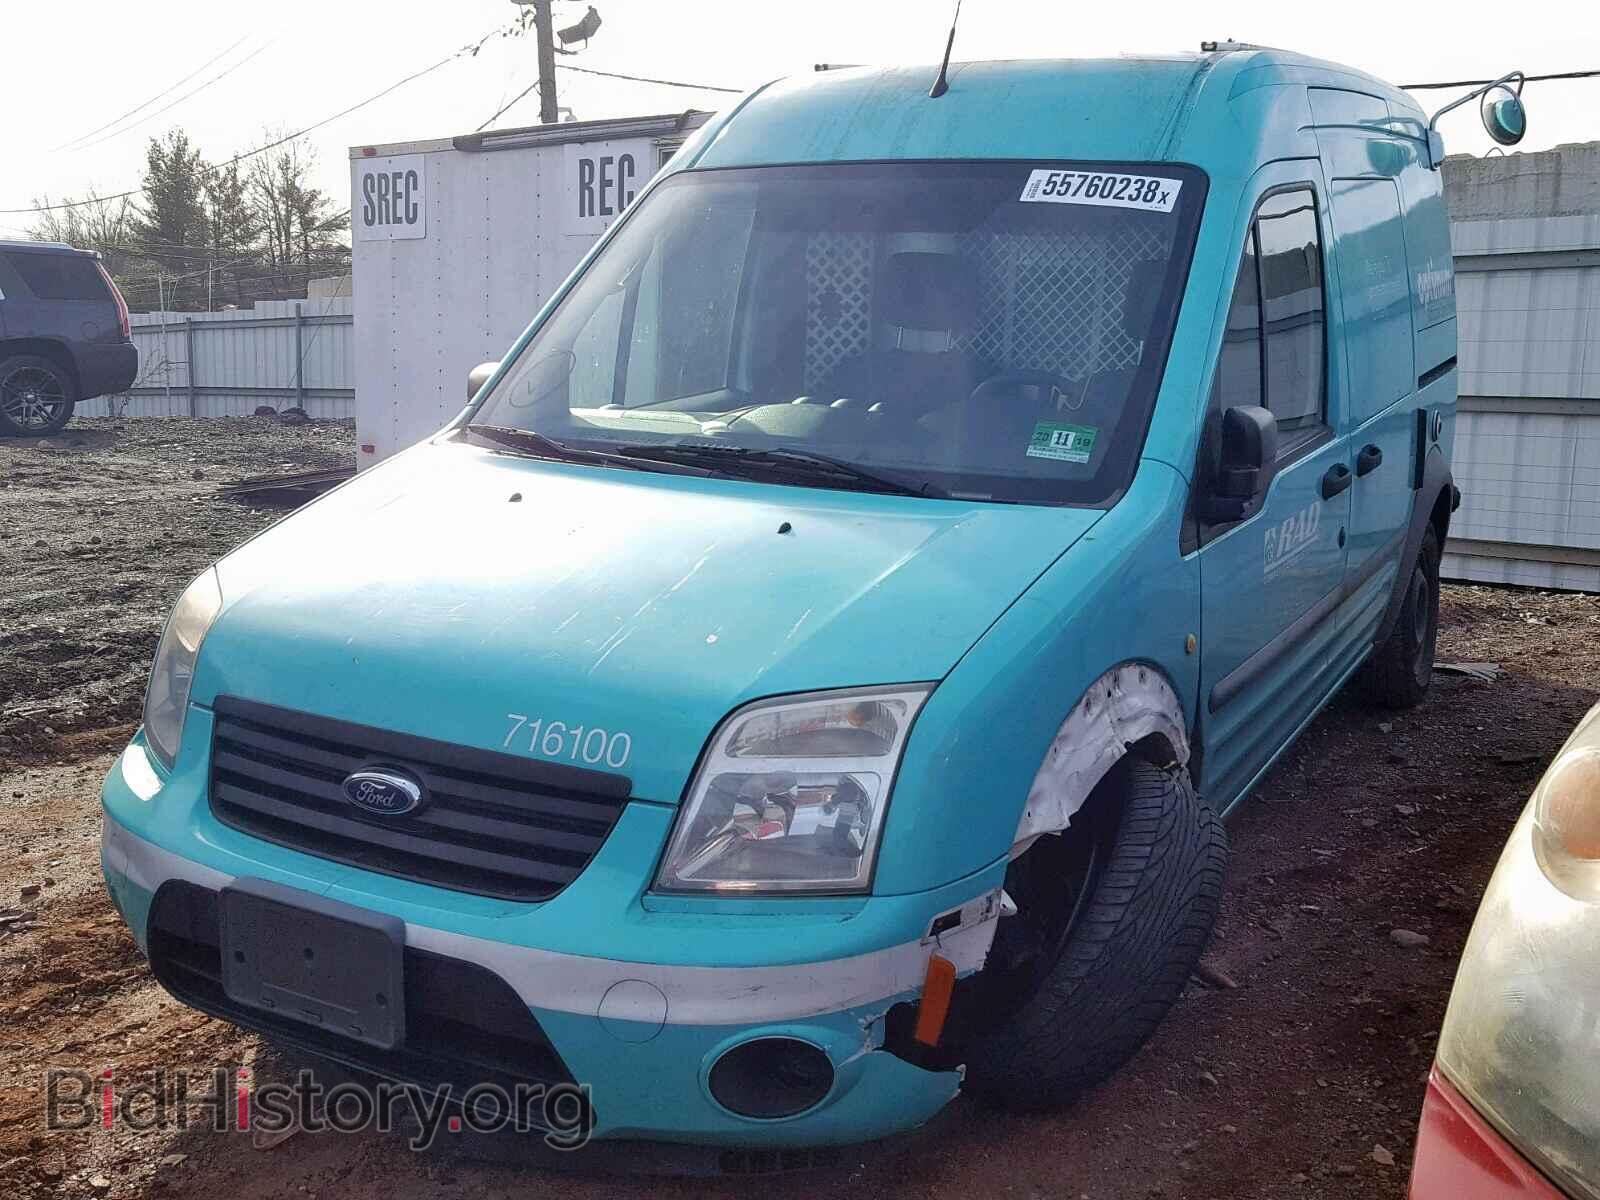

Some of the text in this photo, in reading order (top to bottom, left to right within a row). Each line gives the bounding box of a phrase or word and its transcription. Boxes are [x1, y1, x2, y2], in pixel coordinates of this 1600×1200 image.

[362, 169, 418, 227] SREC
[578, 153, 635, 218] REC
[1055, 431, 1070, 447] 11
[1275, 501, 1321, 559] RAD
[503, 713, 632, 768] 716100
[355, 781, 396, 808] Ford
